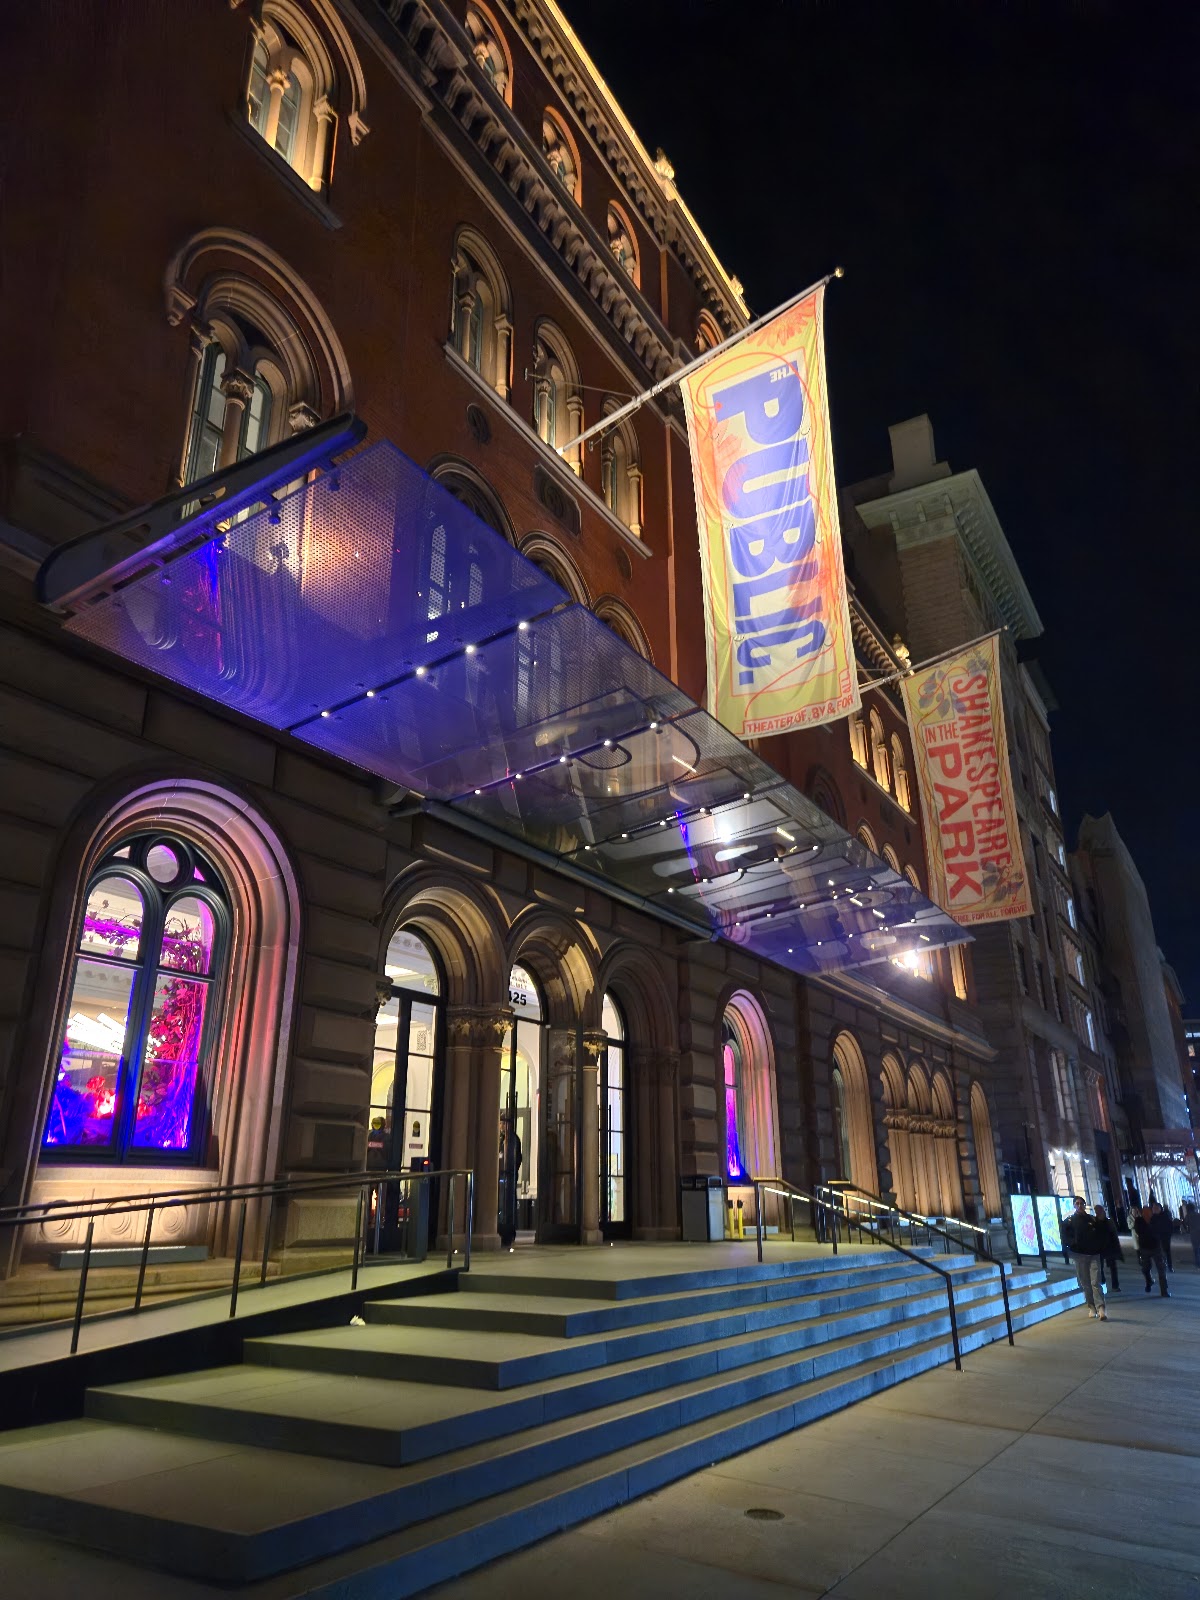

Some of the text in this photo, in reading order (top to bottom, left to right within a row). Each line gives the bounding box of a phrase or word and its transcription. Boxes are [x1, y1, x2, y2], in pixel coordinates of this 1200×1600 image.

[770, 364, 797, 383] THE
[841, 671, 851, 693] ALL
[827, 702, 836, 716] &
[837, 694, 854, 710] FOR
[812, 706, 825, 719] BY
[747, 717, 792, 733] THEATER
[925, 720, 960, 743] IN THE
[952, 673, 1012, 871] SHAKESPEARE
[927, 742, 983, 900] PARK
